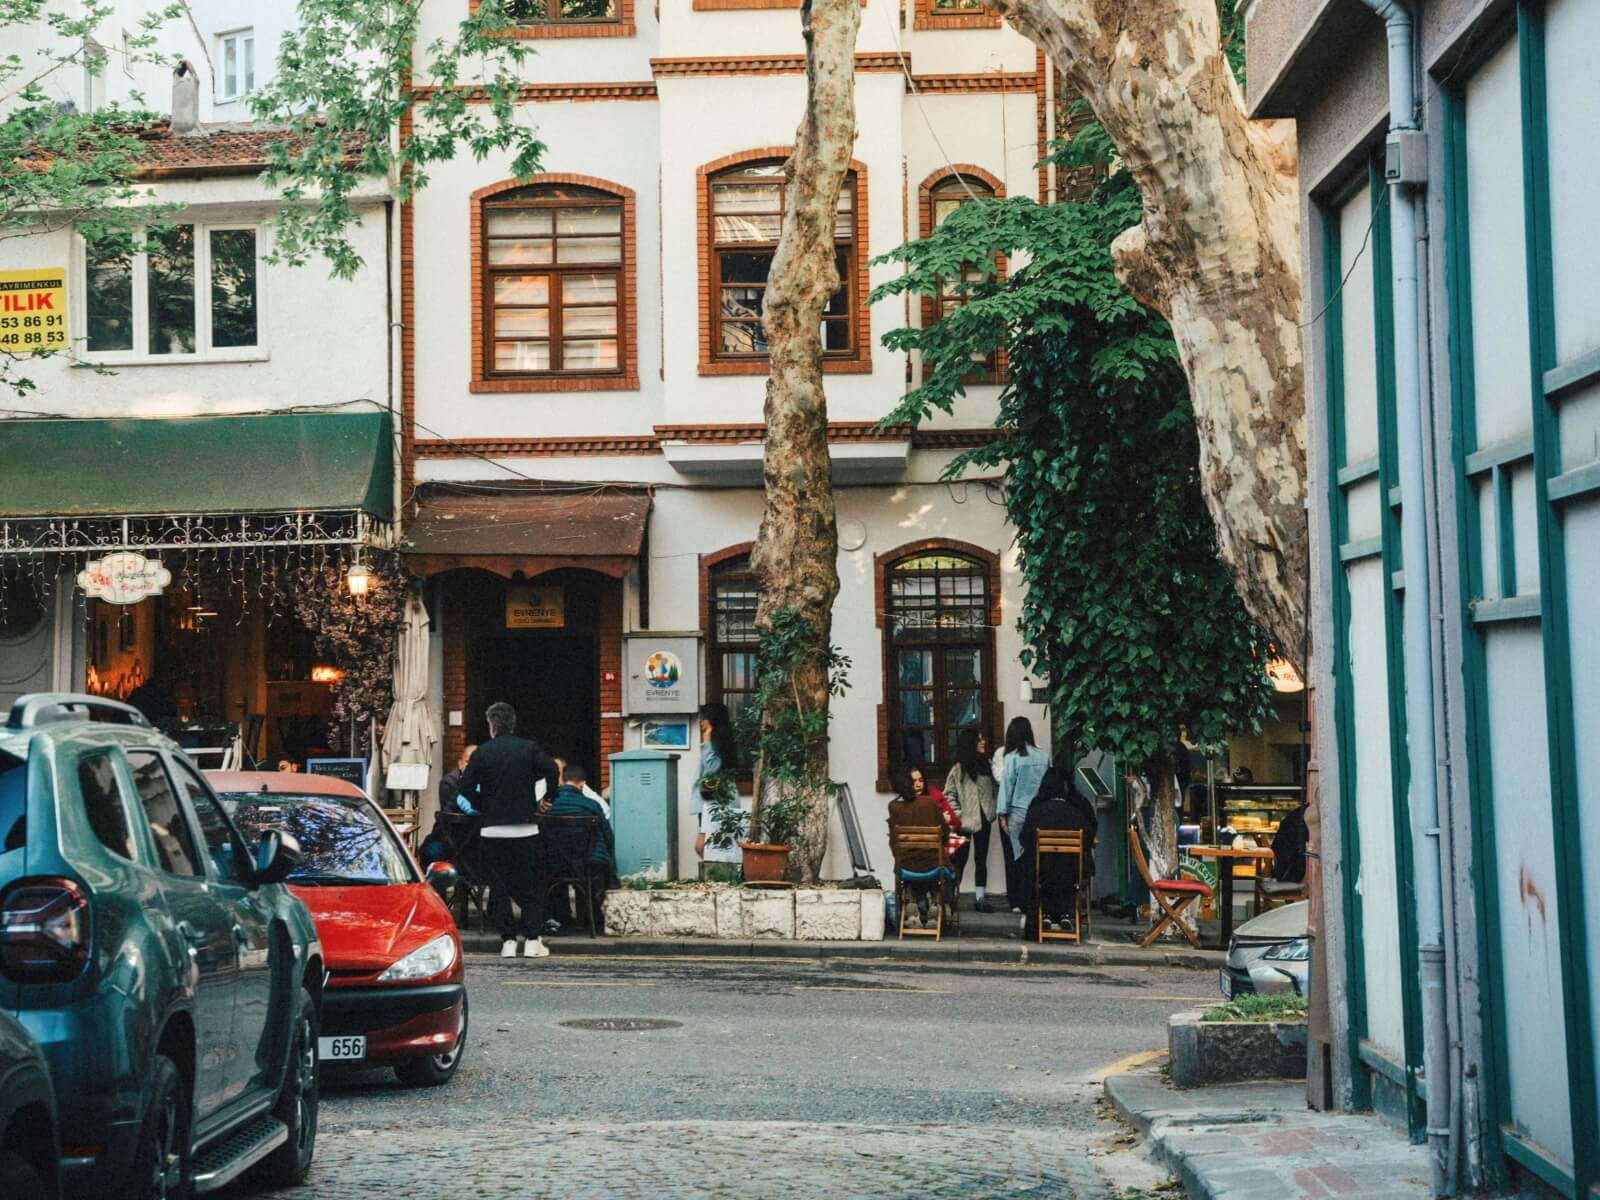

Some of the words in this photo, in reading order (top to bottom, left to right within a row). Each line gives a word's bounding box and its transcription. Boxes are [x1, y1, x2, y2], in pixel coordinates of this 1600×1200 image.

[0, 281, 60, 290] AYRIMENKUL
[0, 292, 54, 312] ILIK
[1, 317, 19, 329] 53
[24, 316, 41, 327] 86
[46, 315, 62, 326] 91
[1, 334, 19, 344] 48
[24, 332, 41, 343] 88
[47, 331, 64, 342] 53
[332, 1038, 361, 1056] 656
